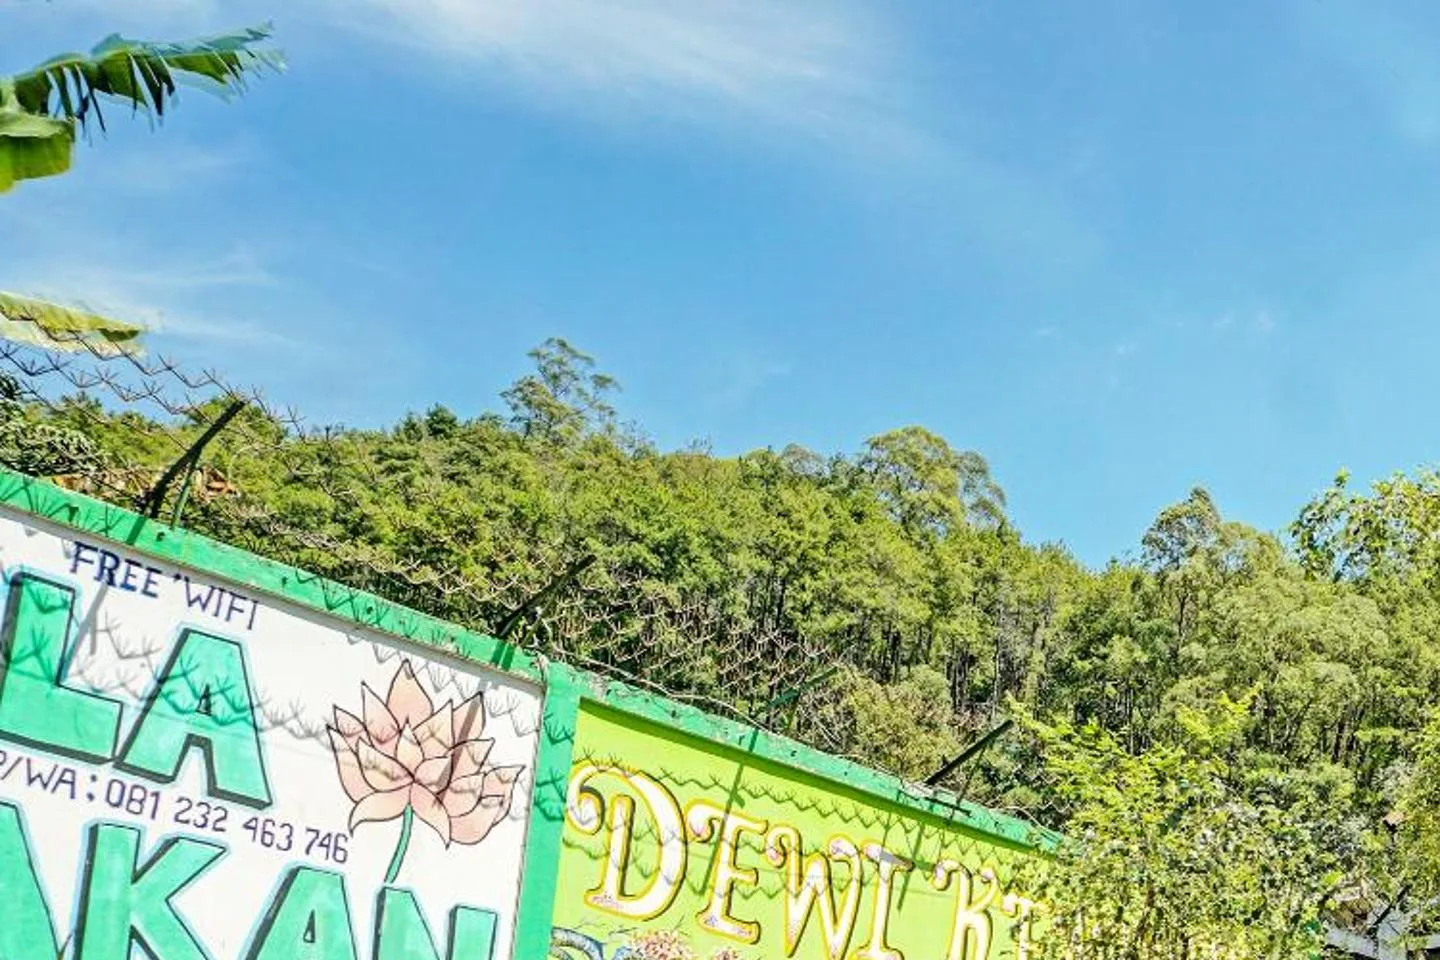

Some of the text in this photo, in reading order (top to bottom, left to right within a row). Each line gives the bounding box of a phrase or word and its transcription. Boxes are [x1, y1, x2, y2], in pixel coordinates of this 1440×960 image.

[70, 541, 258, 631] FREE WIFI
[105, 778, 160, 821] 081
[173, 796, 229, 833] 232
[242, 816, 294, 852] 463
[304, 828, 349, 864] 746
